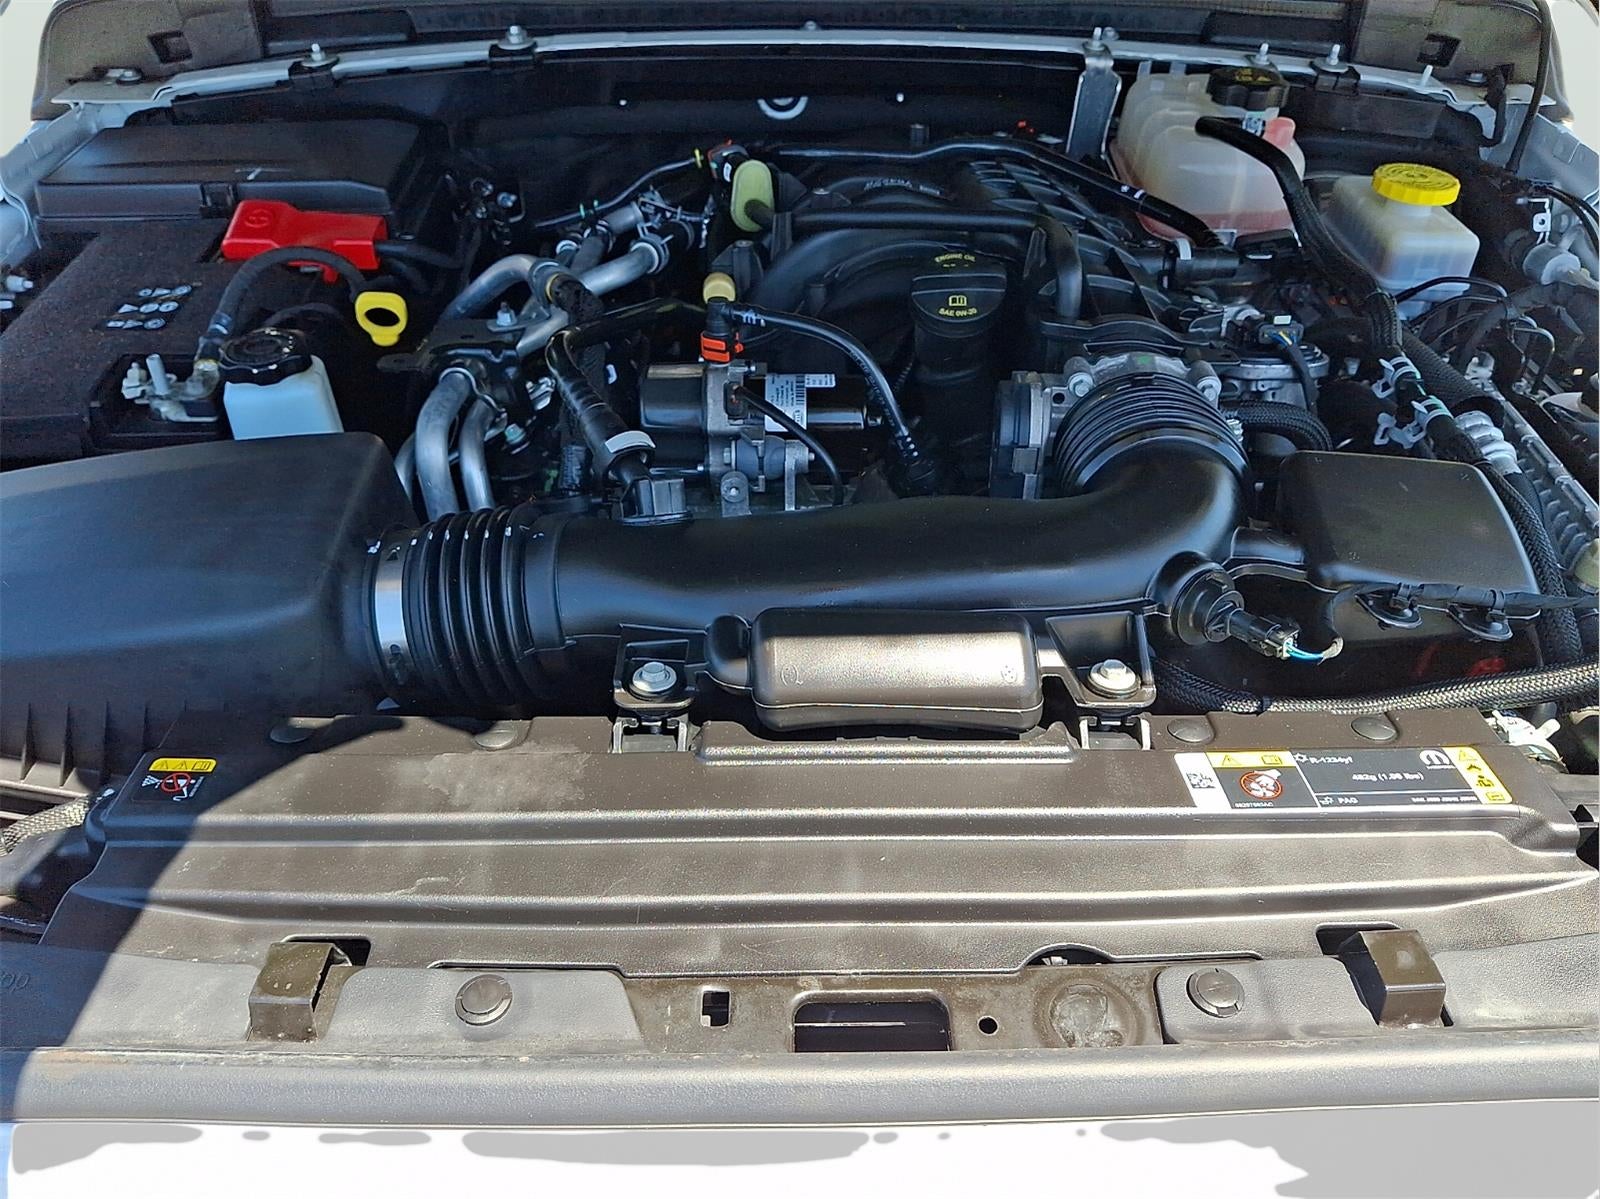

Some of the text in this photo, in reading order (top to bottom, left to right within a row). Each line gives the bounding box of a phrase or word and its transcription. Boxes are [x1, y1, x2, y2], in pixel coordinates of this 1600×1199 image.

[935, 253, 976, 263] ENGINE OIL
[939, 308, 955, 317] SAE
